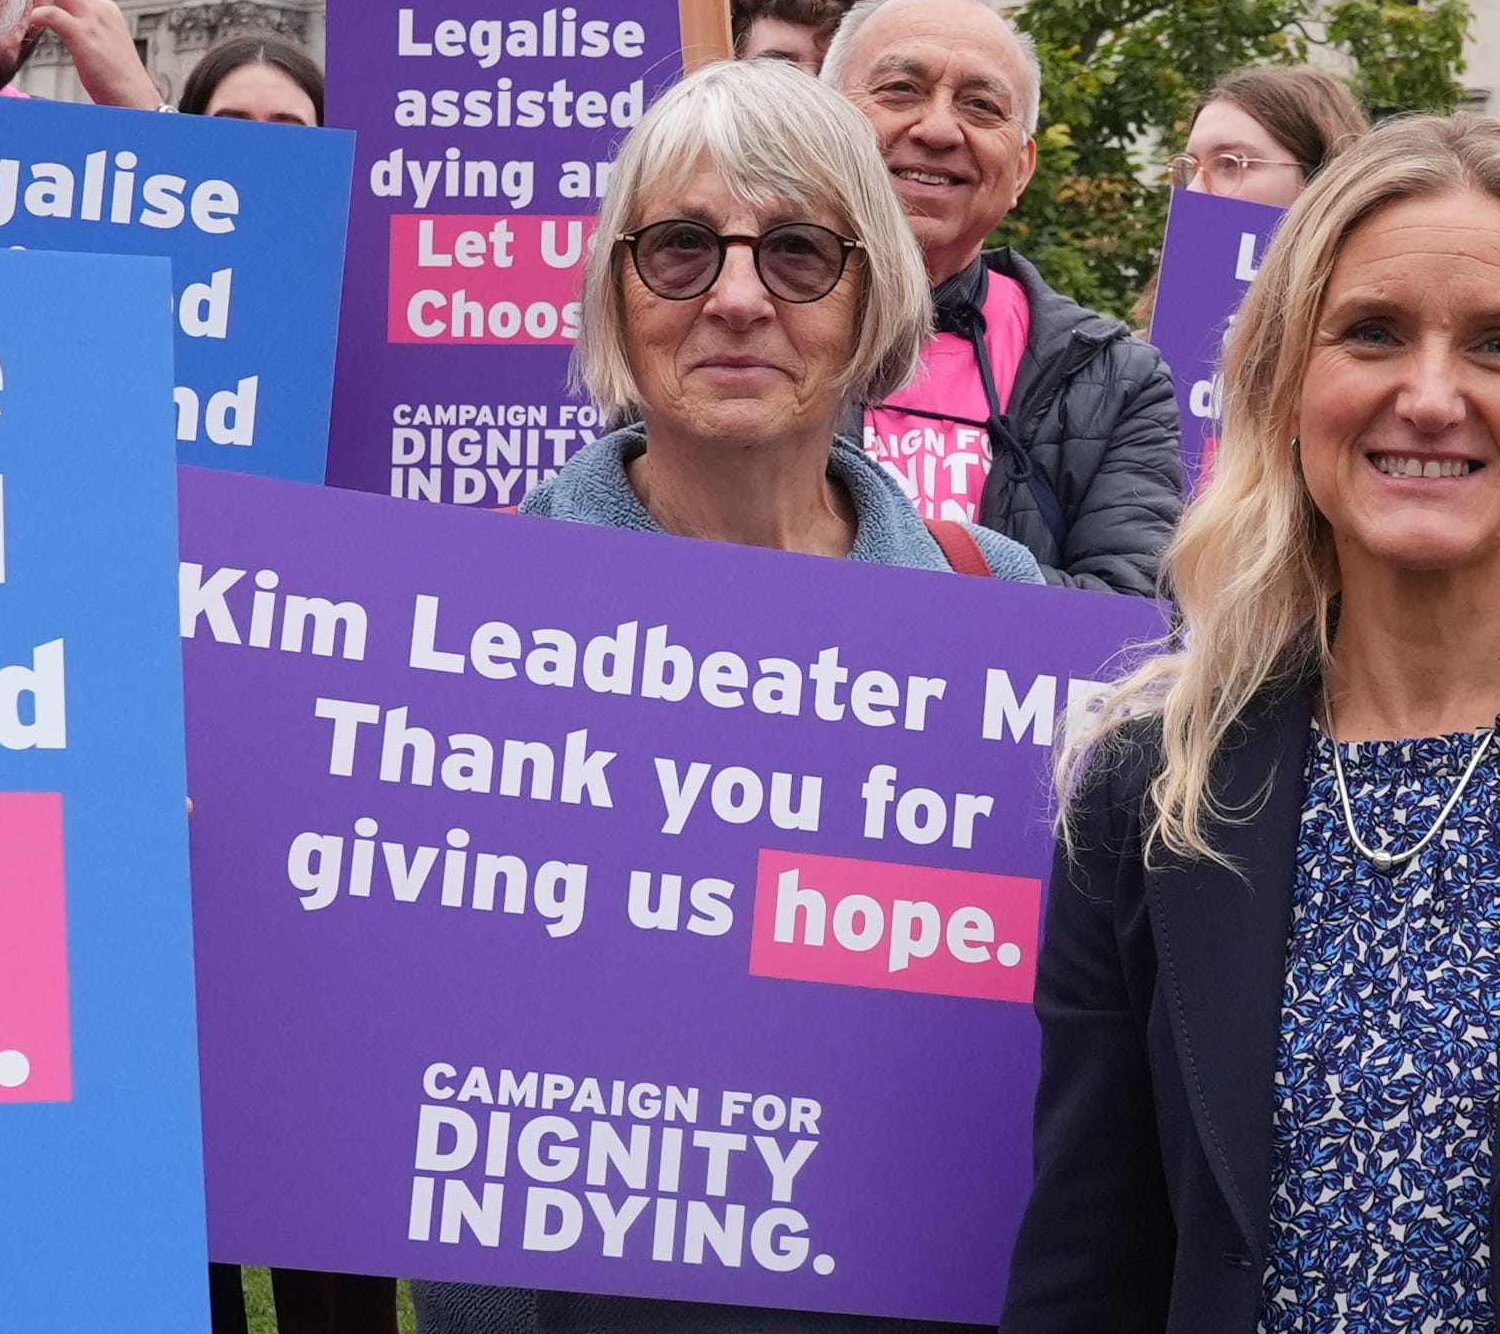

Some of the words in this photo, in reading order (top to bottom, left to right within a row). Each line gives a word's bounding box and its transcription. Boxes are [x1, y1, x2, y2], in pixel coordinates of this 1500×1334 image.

[399, 8, 644, 67] Legalise
[394, 78, 644, 128] assisted
[371, 148, 533, 208] dying
[420, 221, 513, 267] Let
[541, 220, 596, 269] U
[407, 289, 581, 339] Choos
[394, 405, 546, 426] CAMPAIGN
[560, 404, 608, 427] FO
[391, 468, 439, 501] IN
[180, 562, 368, 661] Kim
[410, 595, 946, 730] Leadbeater
[981, 668, 1120, 749] MP
[316, 699, 616, 807] Thank
[655, 758, 822, 834] you
[862, 765, 994, 848] for
[289, 818, 587, 937] giving
[629, 871, 734, 935] us
[775, 870, 1020, 971] hope.
[424, 1063, 698, 1122] CAMPAIGN
[721, 1091, 821, 1134] FOR
[414, 1105, 819, 1204] DIGNITY
[409, 1177, 504, 1246] IN
[523, 1187, 834, 1275] DYING.
